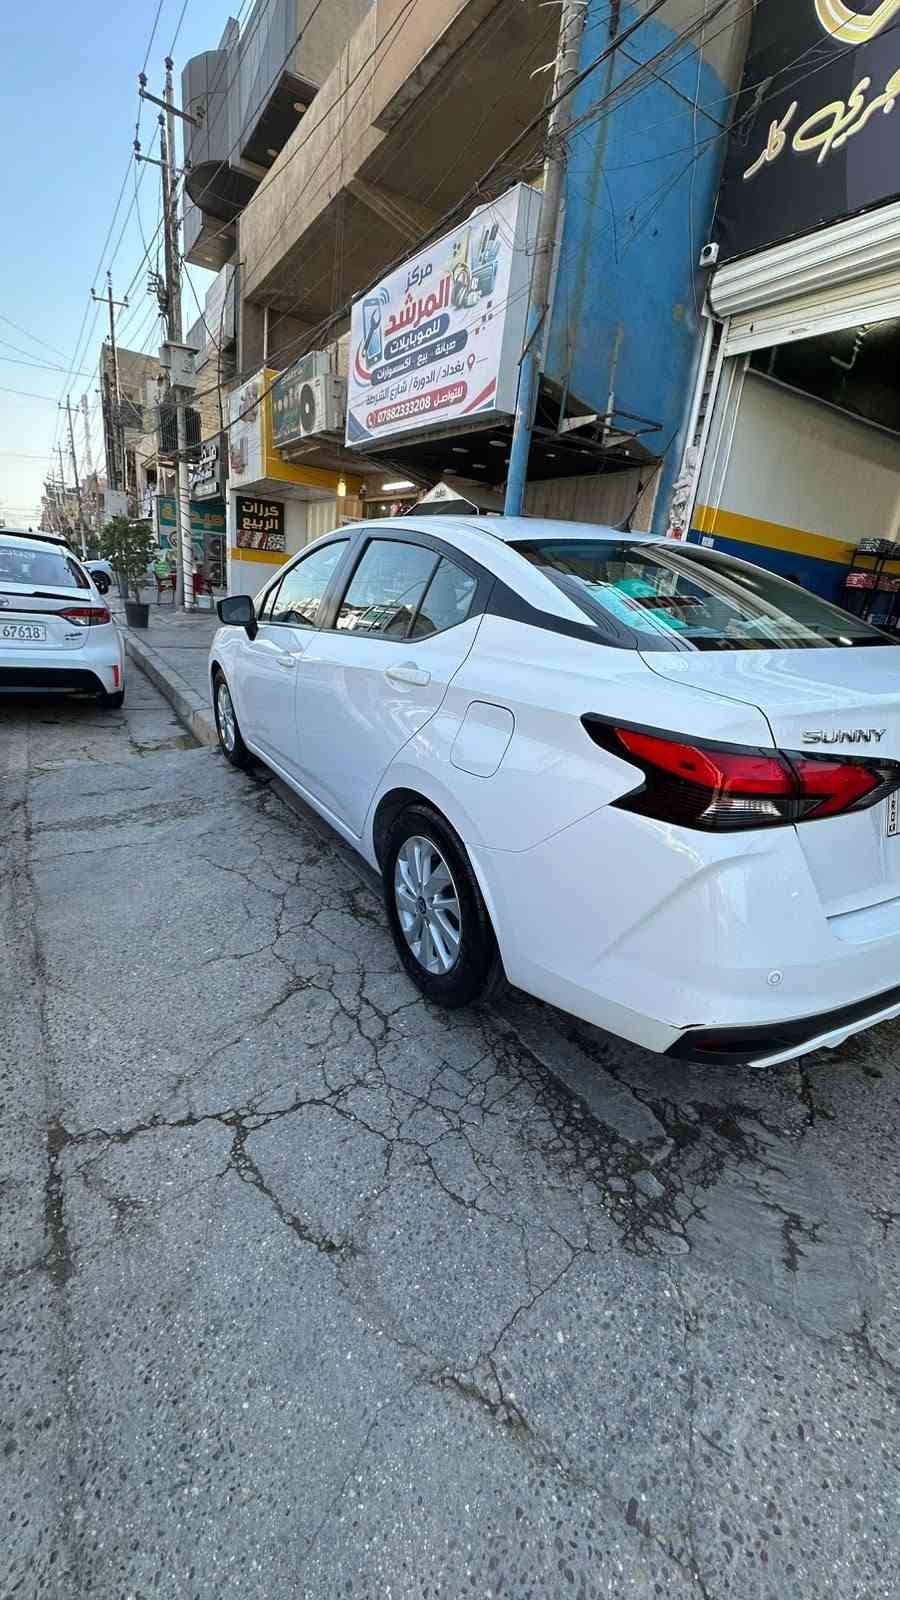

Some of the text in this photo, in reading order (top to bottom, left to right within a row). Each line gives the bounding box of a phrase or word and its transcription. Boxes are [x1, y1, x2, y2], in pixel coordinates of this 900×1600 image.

[743, 101, 798, 179] كار
[405, 263, 433, 293] مركز
[384, 275, 451, 336] المرشد
[390, 318, 440, 354] للموبايلات
[435, 340, 456, 355] صيانة
[416, 352, 428, 365] بيع
[433, 387, 463, 406] للتواصل
[241, 501, 279, 517] كرزات
[242, 517, 278, 530] الربيع
[3, 625, 40, 639] 67618
[802, 729, 887, 744] SUNNY
